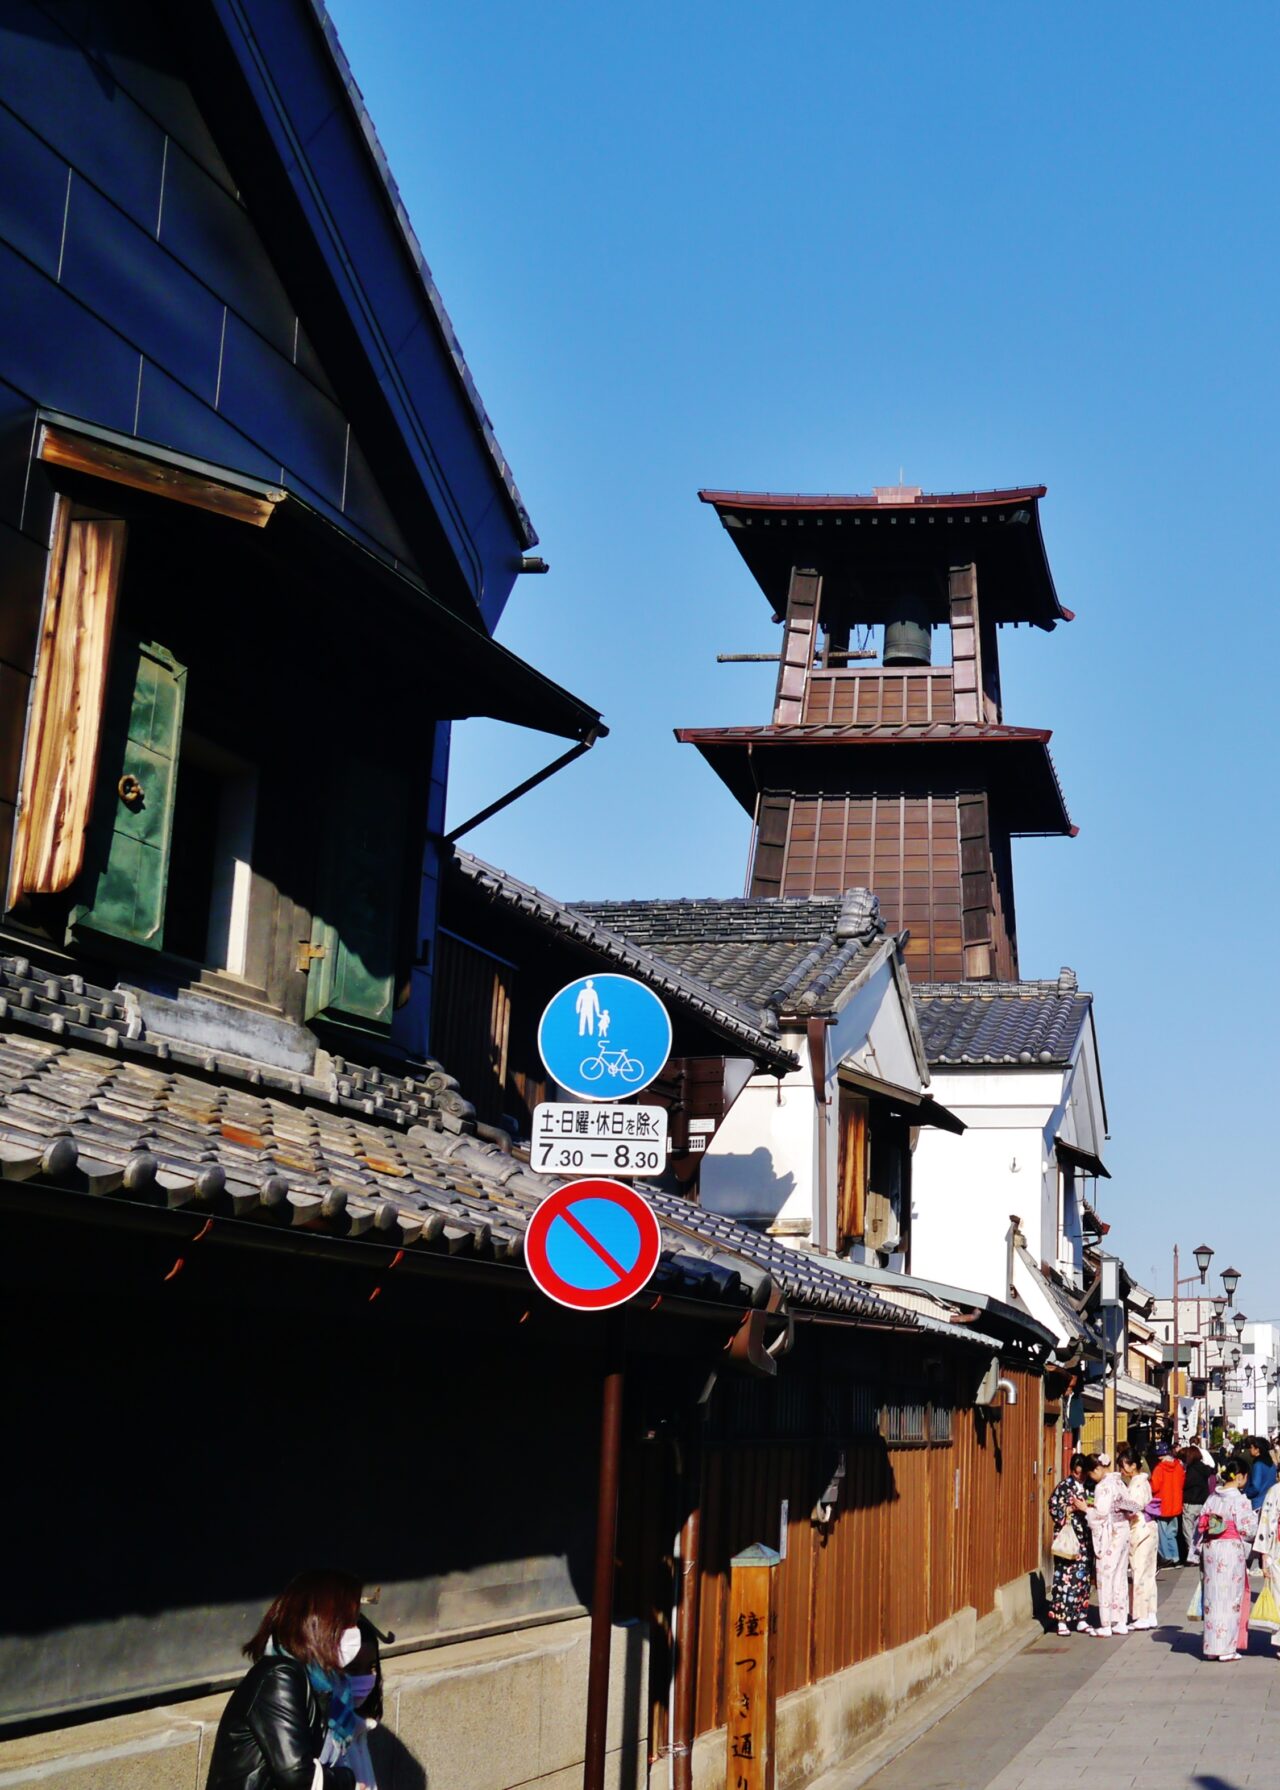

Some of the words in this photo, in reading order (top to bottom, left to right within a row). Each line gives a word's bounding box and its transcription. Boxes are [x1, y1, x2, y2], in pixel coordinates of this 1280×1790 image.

[540, 1110, 660, 1137] 土・日曜・休日を除く
